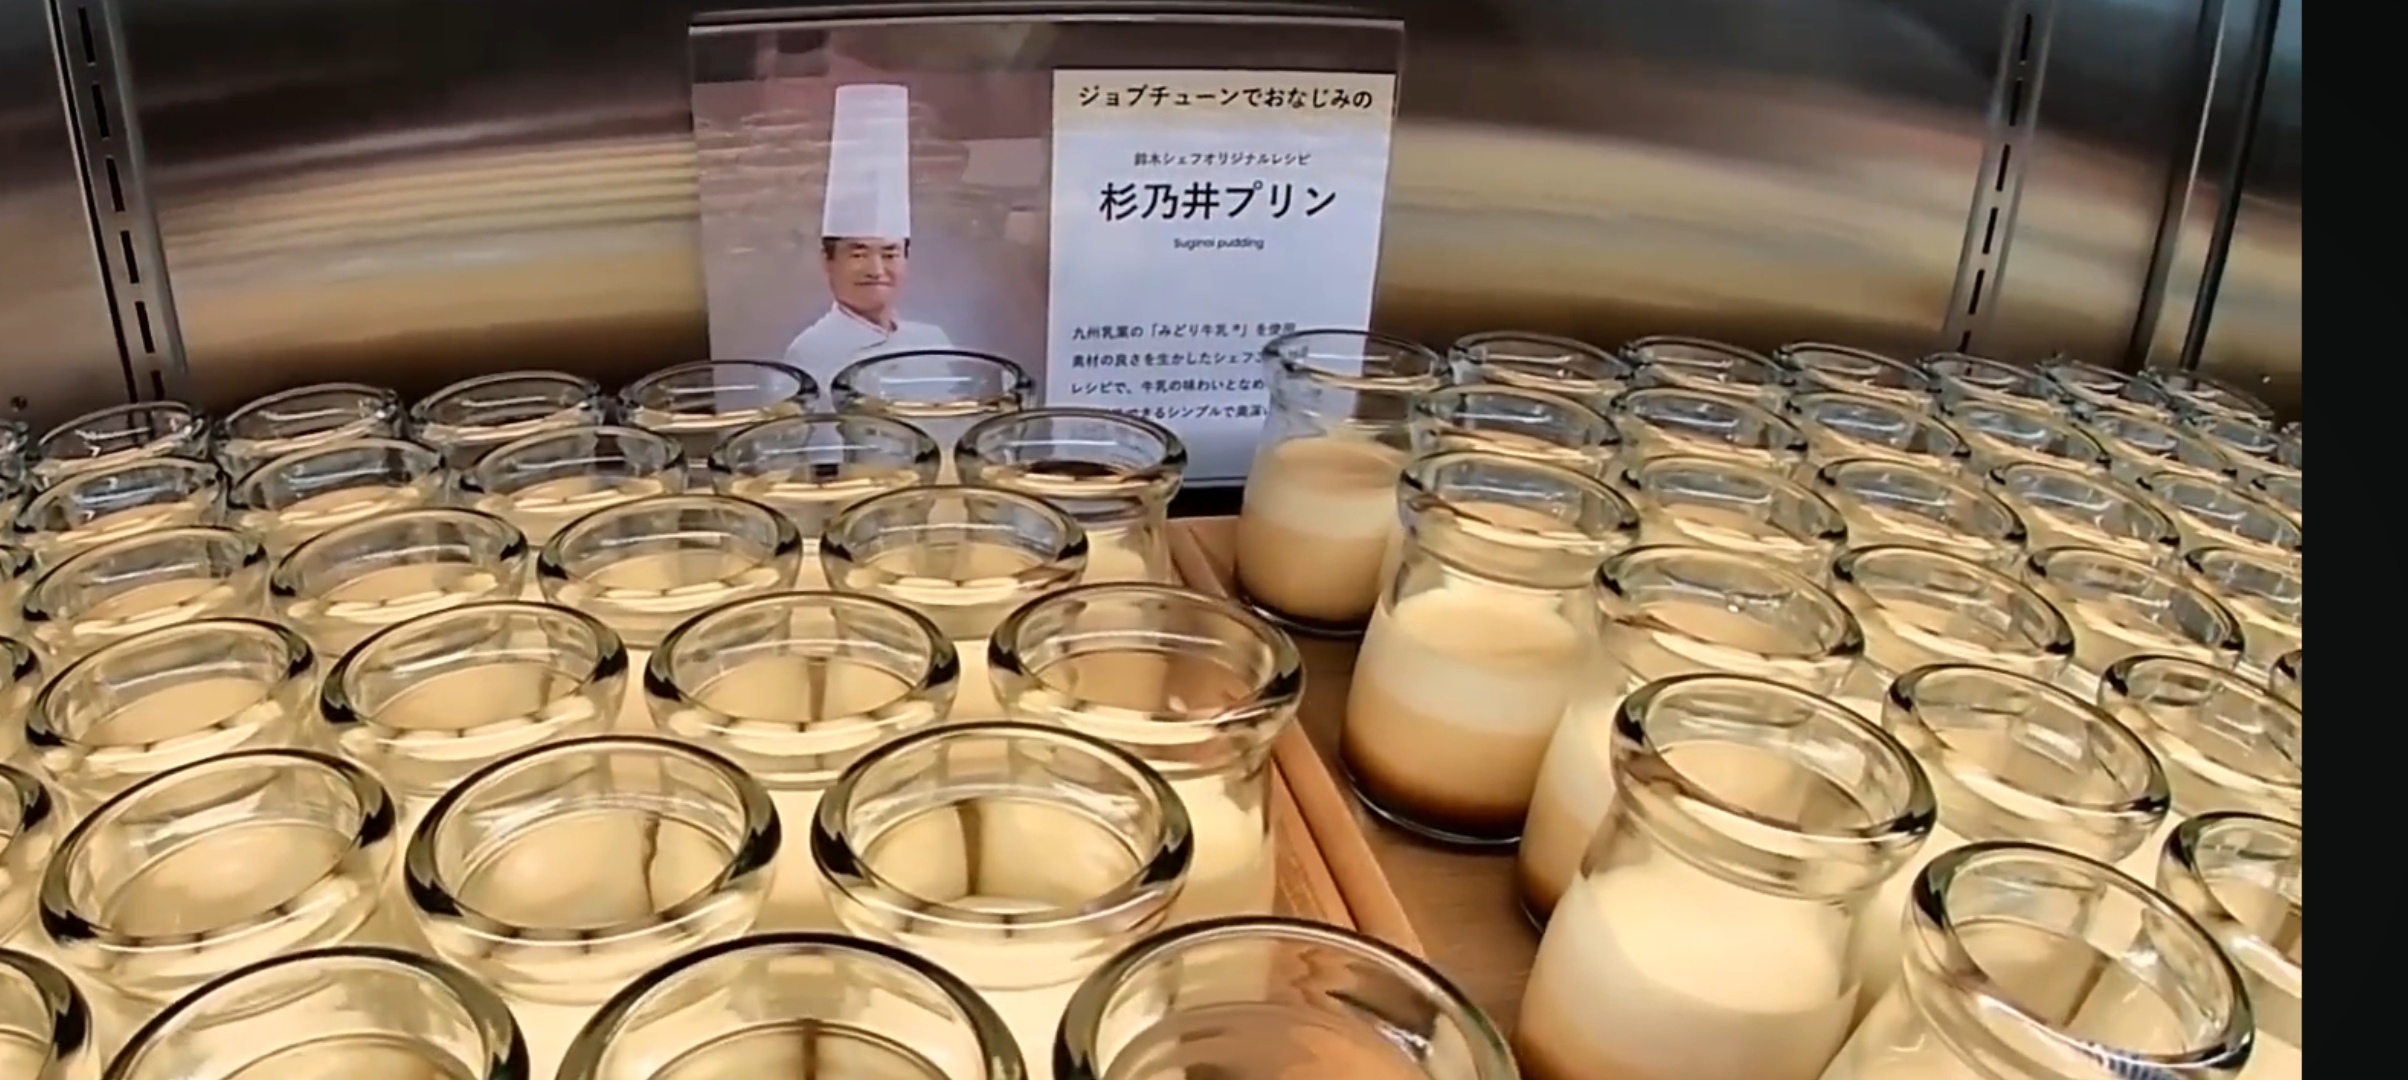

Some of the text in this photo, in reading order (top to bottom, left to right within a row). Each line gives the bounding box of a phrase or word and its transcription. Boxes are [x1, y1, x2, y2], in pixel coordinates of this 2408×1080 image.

[1079, 84, 1372, 109] ジョブチューンでおなじみの
[1134, 152, 1312, 166] 鈴木シェフオリジナルレシピ
[1099, 180, 1336, 221] 杉乃井プリン
[1217, 238, 1264, 250] pudding
[1072, 379, 1268, 395] レシピで、牛乳の味わいとなめ
